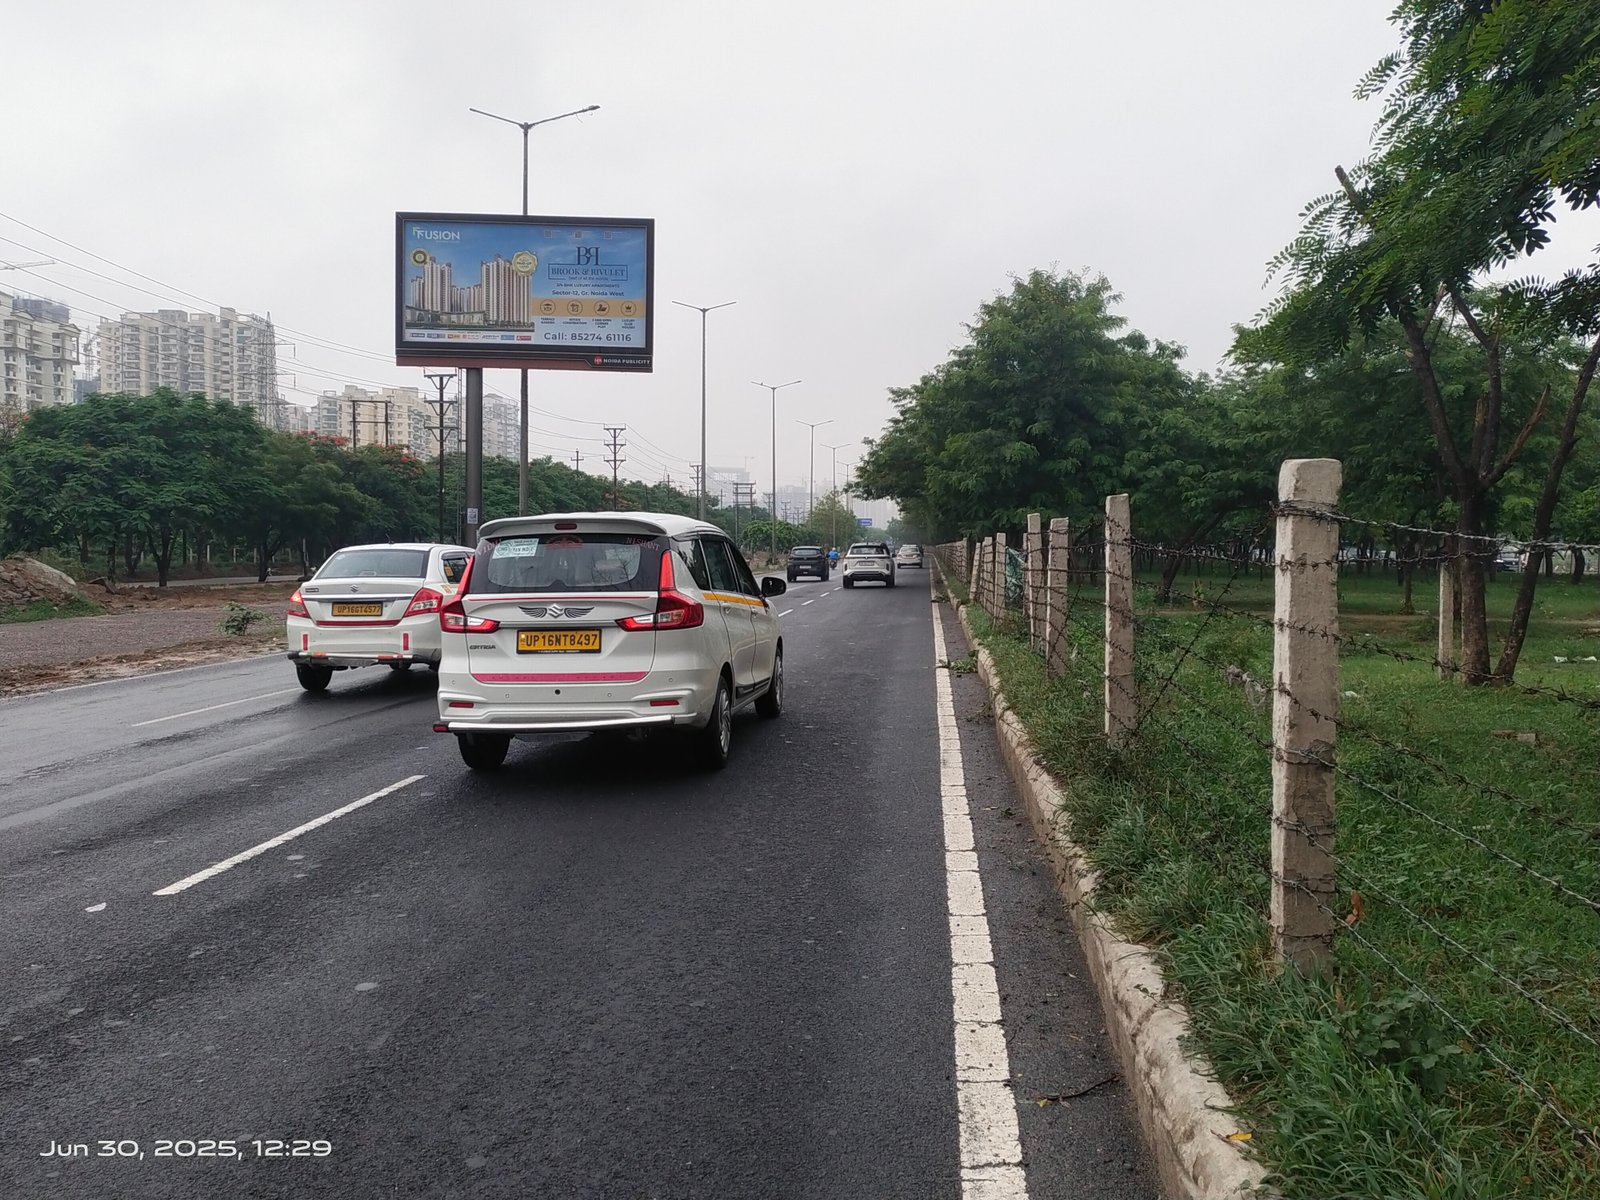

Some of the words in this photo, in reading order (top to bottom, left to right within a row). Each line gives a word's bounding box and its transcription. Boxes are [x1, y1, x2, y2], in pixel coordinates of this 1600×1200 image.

[414, 228, 460, 240] FUSION
[551, 267, 580, 275] BROOK
[582, 268, 590, 276] &
[591, 268, 626, 277] RIVULET
[544, 332, 567, 341] Call:
[571, 333, 602, 341] 85274
[606, 333, 632, 342] 61116
[525, 633, 598, 647] UP16NT8497
